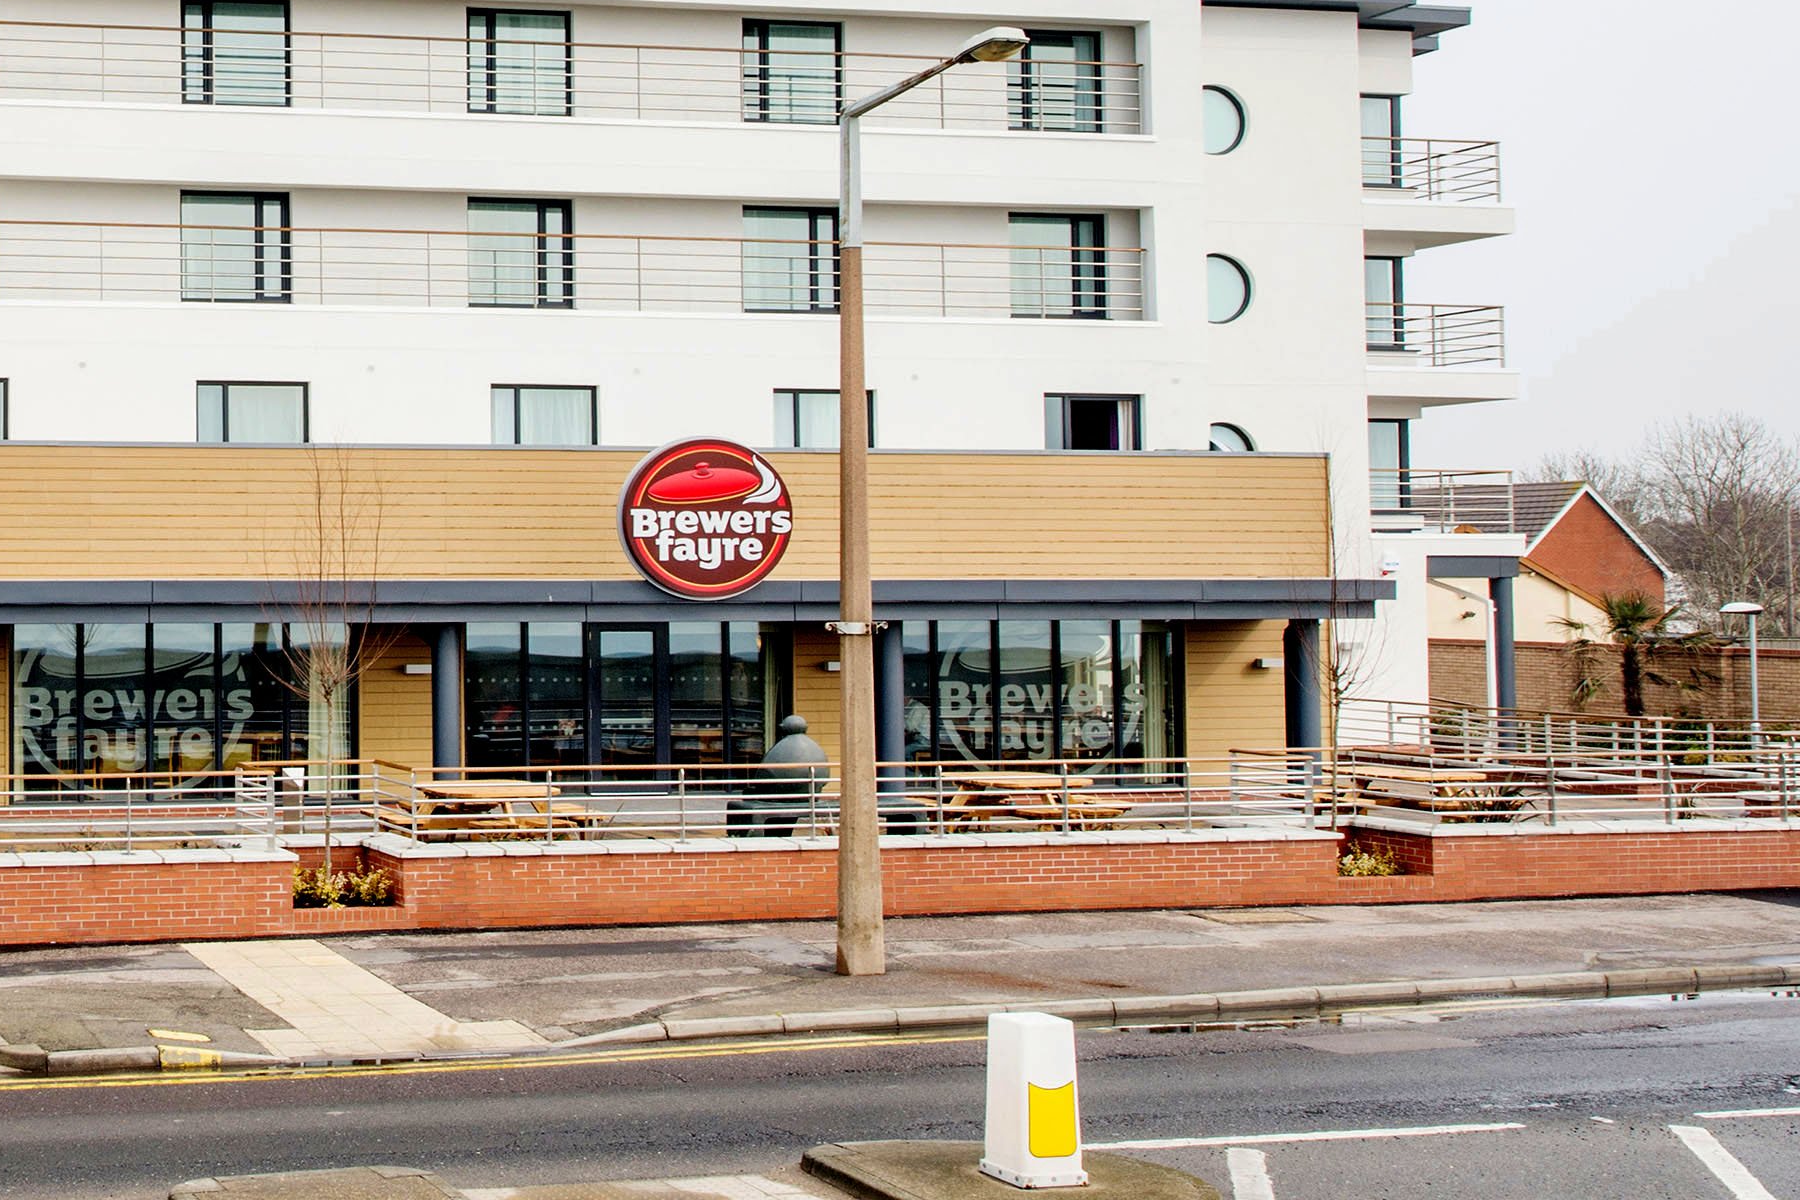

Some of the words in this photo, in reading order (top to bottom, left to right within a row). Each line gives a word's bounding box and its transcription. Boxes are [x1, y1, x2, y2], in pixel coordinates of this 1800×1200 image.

[630, 508, 792, 538] Brewers
[655, 530, 764, 570] fayre
[15, 686, 255, 727] Brewers
[51, 716, 214, 772] fayre
[968, 708, 1112, 760] fayre
